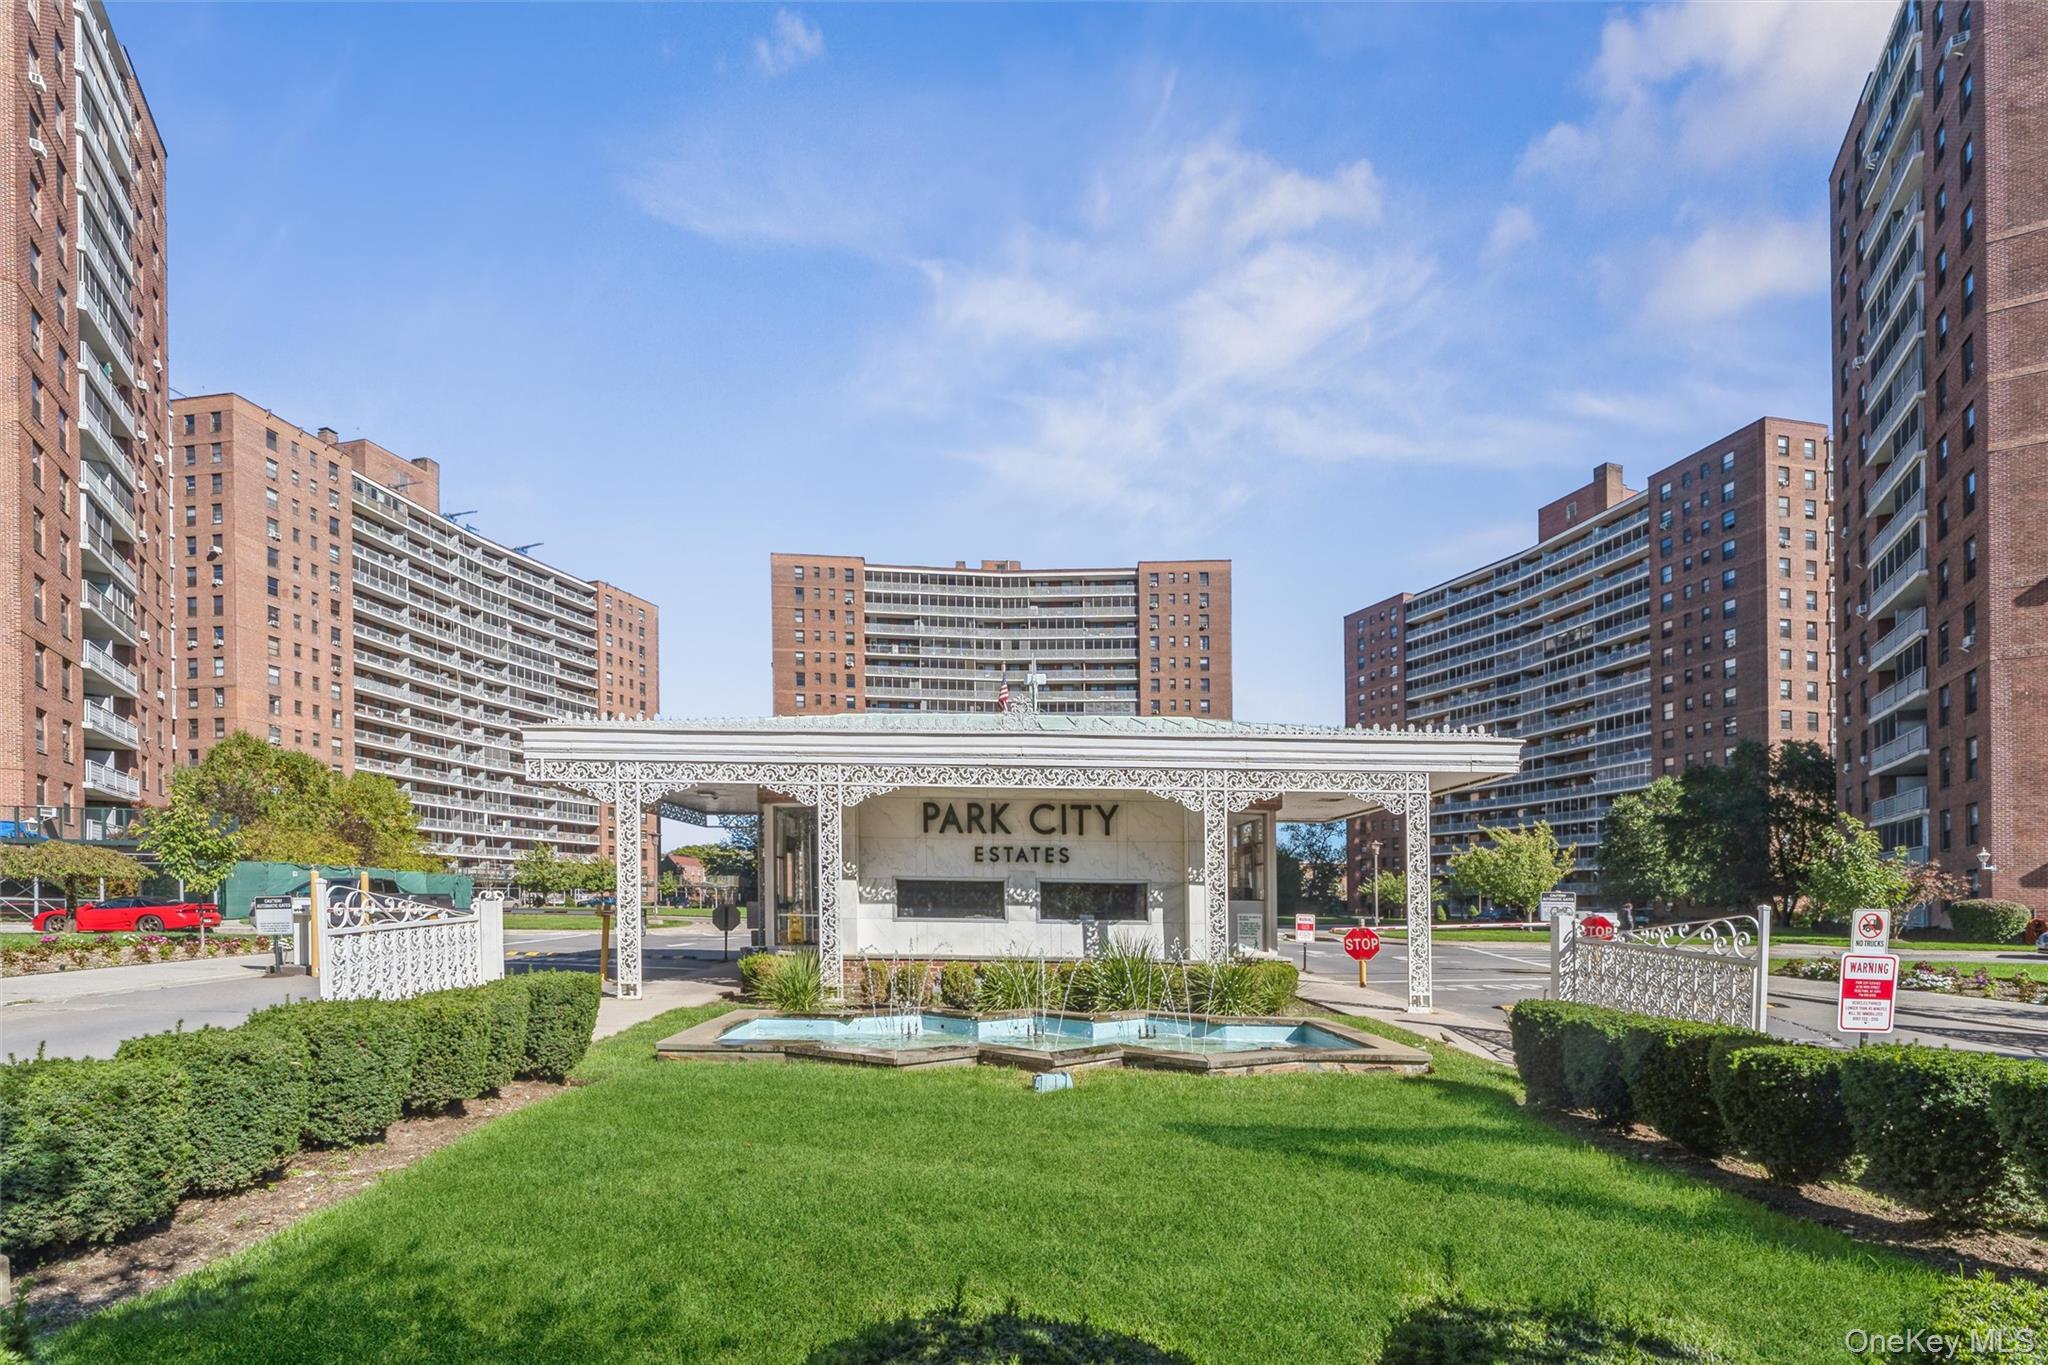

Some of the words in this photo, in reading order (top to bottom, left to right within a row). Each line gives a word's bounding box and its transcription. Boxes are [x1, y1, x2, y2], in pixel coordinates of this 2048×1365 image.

[923, 802, 1011, 834] PARK
[1029, 803, 1119, 836] CITY
[974, 846, 1070, 864] ESTATES
[1345, 938, 1378, 951] STOP
[1850, 962, 1889, 975] WARNING
